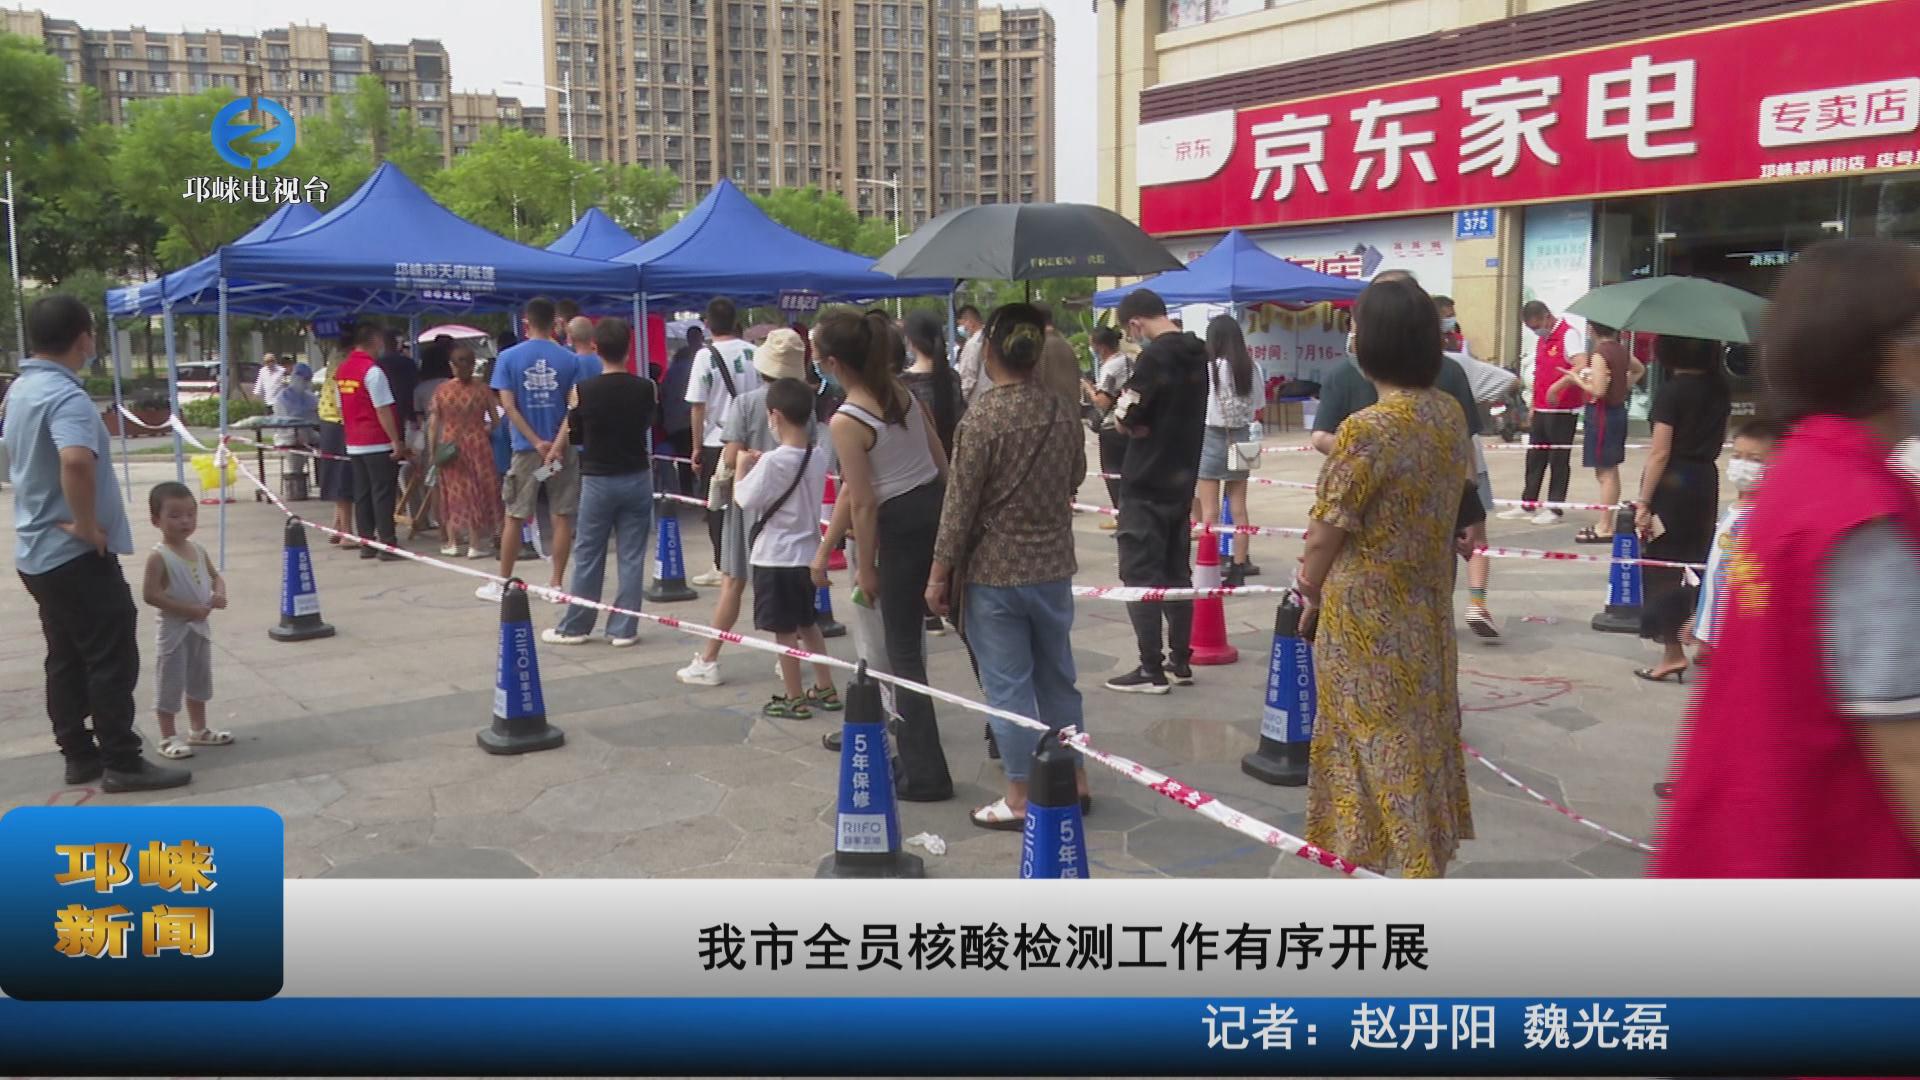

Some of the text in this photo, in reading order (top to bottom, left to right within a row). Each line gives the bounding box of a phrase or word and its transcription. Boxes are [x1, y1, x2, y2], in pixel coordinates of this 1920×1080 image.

[1250, 55, 1697, 203] 京东家电
[1772, 89, 1908, 134] 专卖店
[1463, 217, 1489, 231] 375
[515, 627, 530, 669] RIIFO
[1295, 641, 1310, 688] RIIFO
[851, 733, 872, 810] 5年保修
[842, 821, 882, 834] RIIFO
[1022, 812, 1037, 879] RIIFO
